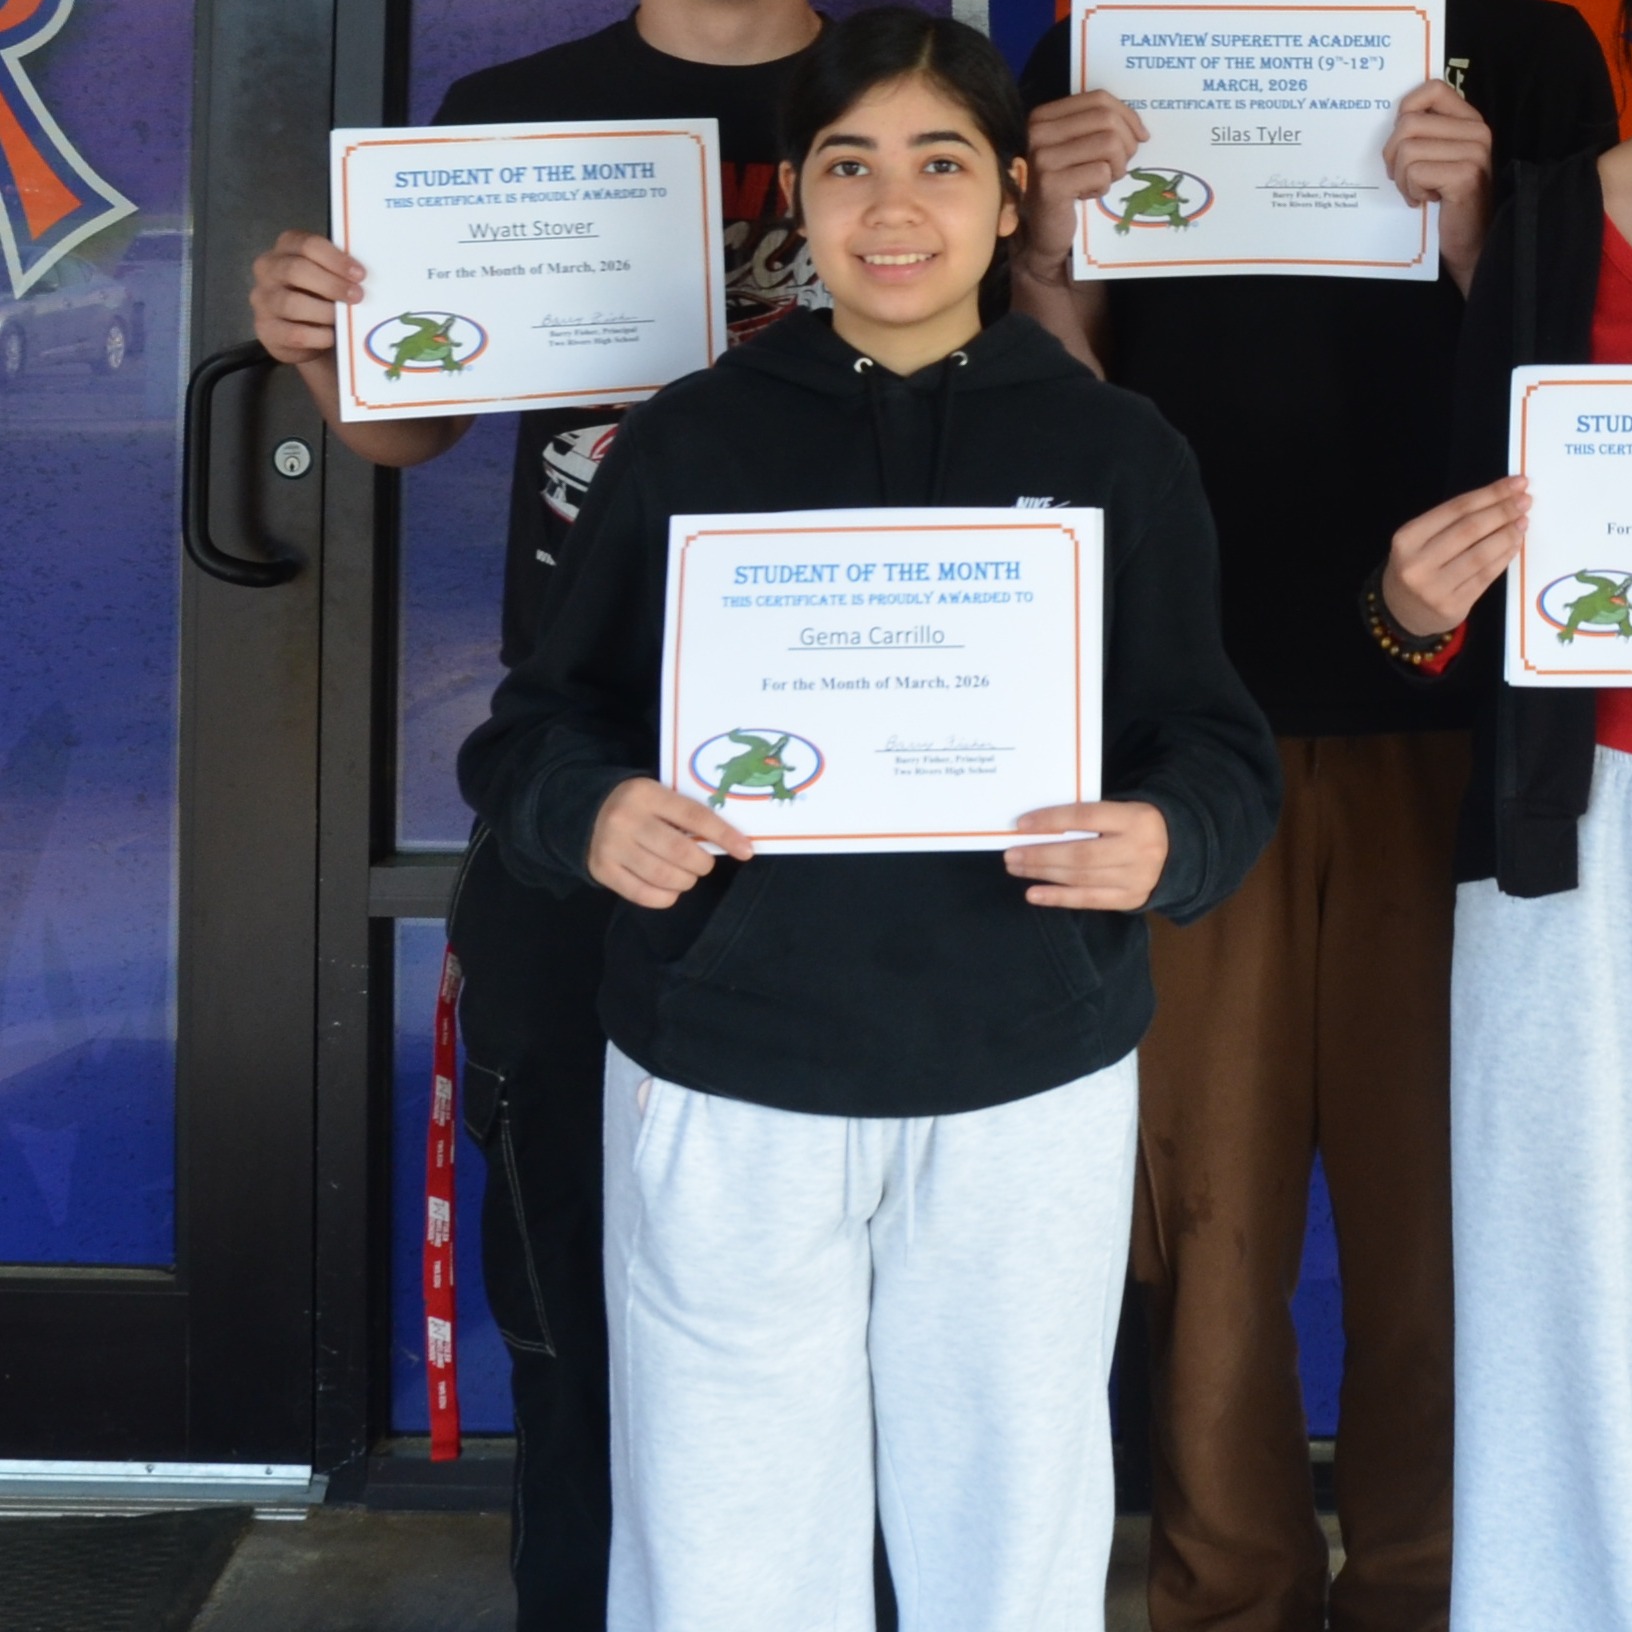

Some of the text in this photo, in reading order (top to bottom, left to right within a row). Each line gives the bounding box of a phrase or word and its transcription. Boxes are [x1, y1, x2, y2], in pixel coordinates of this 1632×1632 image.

[1120, 32, 1390, 48] PLAINVIEW SUPERETTE ACADEMIC
[1125, 56, 1196, 70] STUDENT
[1200, 56, 1221, 69] OF
[1224, 56, 1256, 70] THE
[1259, 56, 1313, 70] MONTH
[1202, 78, 1307, 93] MARCH, 2026
[1150, 99, 1232, 110] CERTIFICATE
[1235, 99, 1246, 110] IS
[1249, 98, 1306, 110] PROUDLY
[1309, 98, 1371, 110] AWARDED
[1374, 99, 1391, 110] TO
[1211, 126, 1301, 143] Silas Tyler
[394, 161, 654, 188] STUDENT OF THE MONTH
[384, 186, 667, 208] THIS CERTIFICATE IS PROUDLY AWARDED TO
[468, 220, 595, 242] Wyatt Stover
[427, 259, 631, 280] For the Month of March, 2026
[1563, 443, 1596, 455] THIS
[1606, 522, 1632, 535] For
[733, 560, 1020, 585] STUDENT OF THE MONTH
[721, 590, 1034, 608] THIS CERTIFICATE IS PROUDLY AWARDED TO
[798, 625, 947, 646] Gema Carrillo
[761, 674, 990, 691] For the Month of March, 2026
